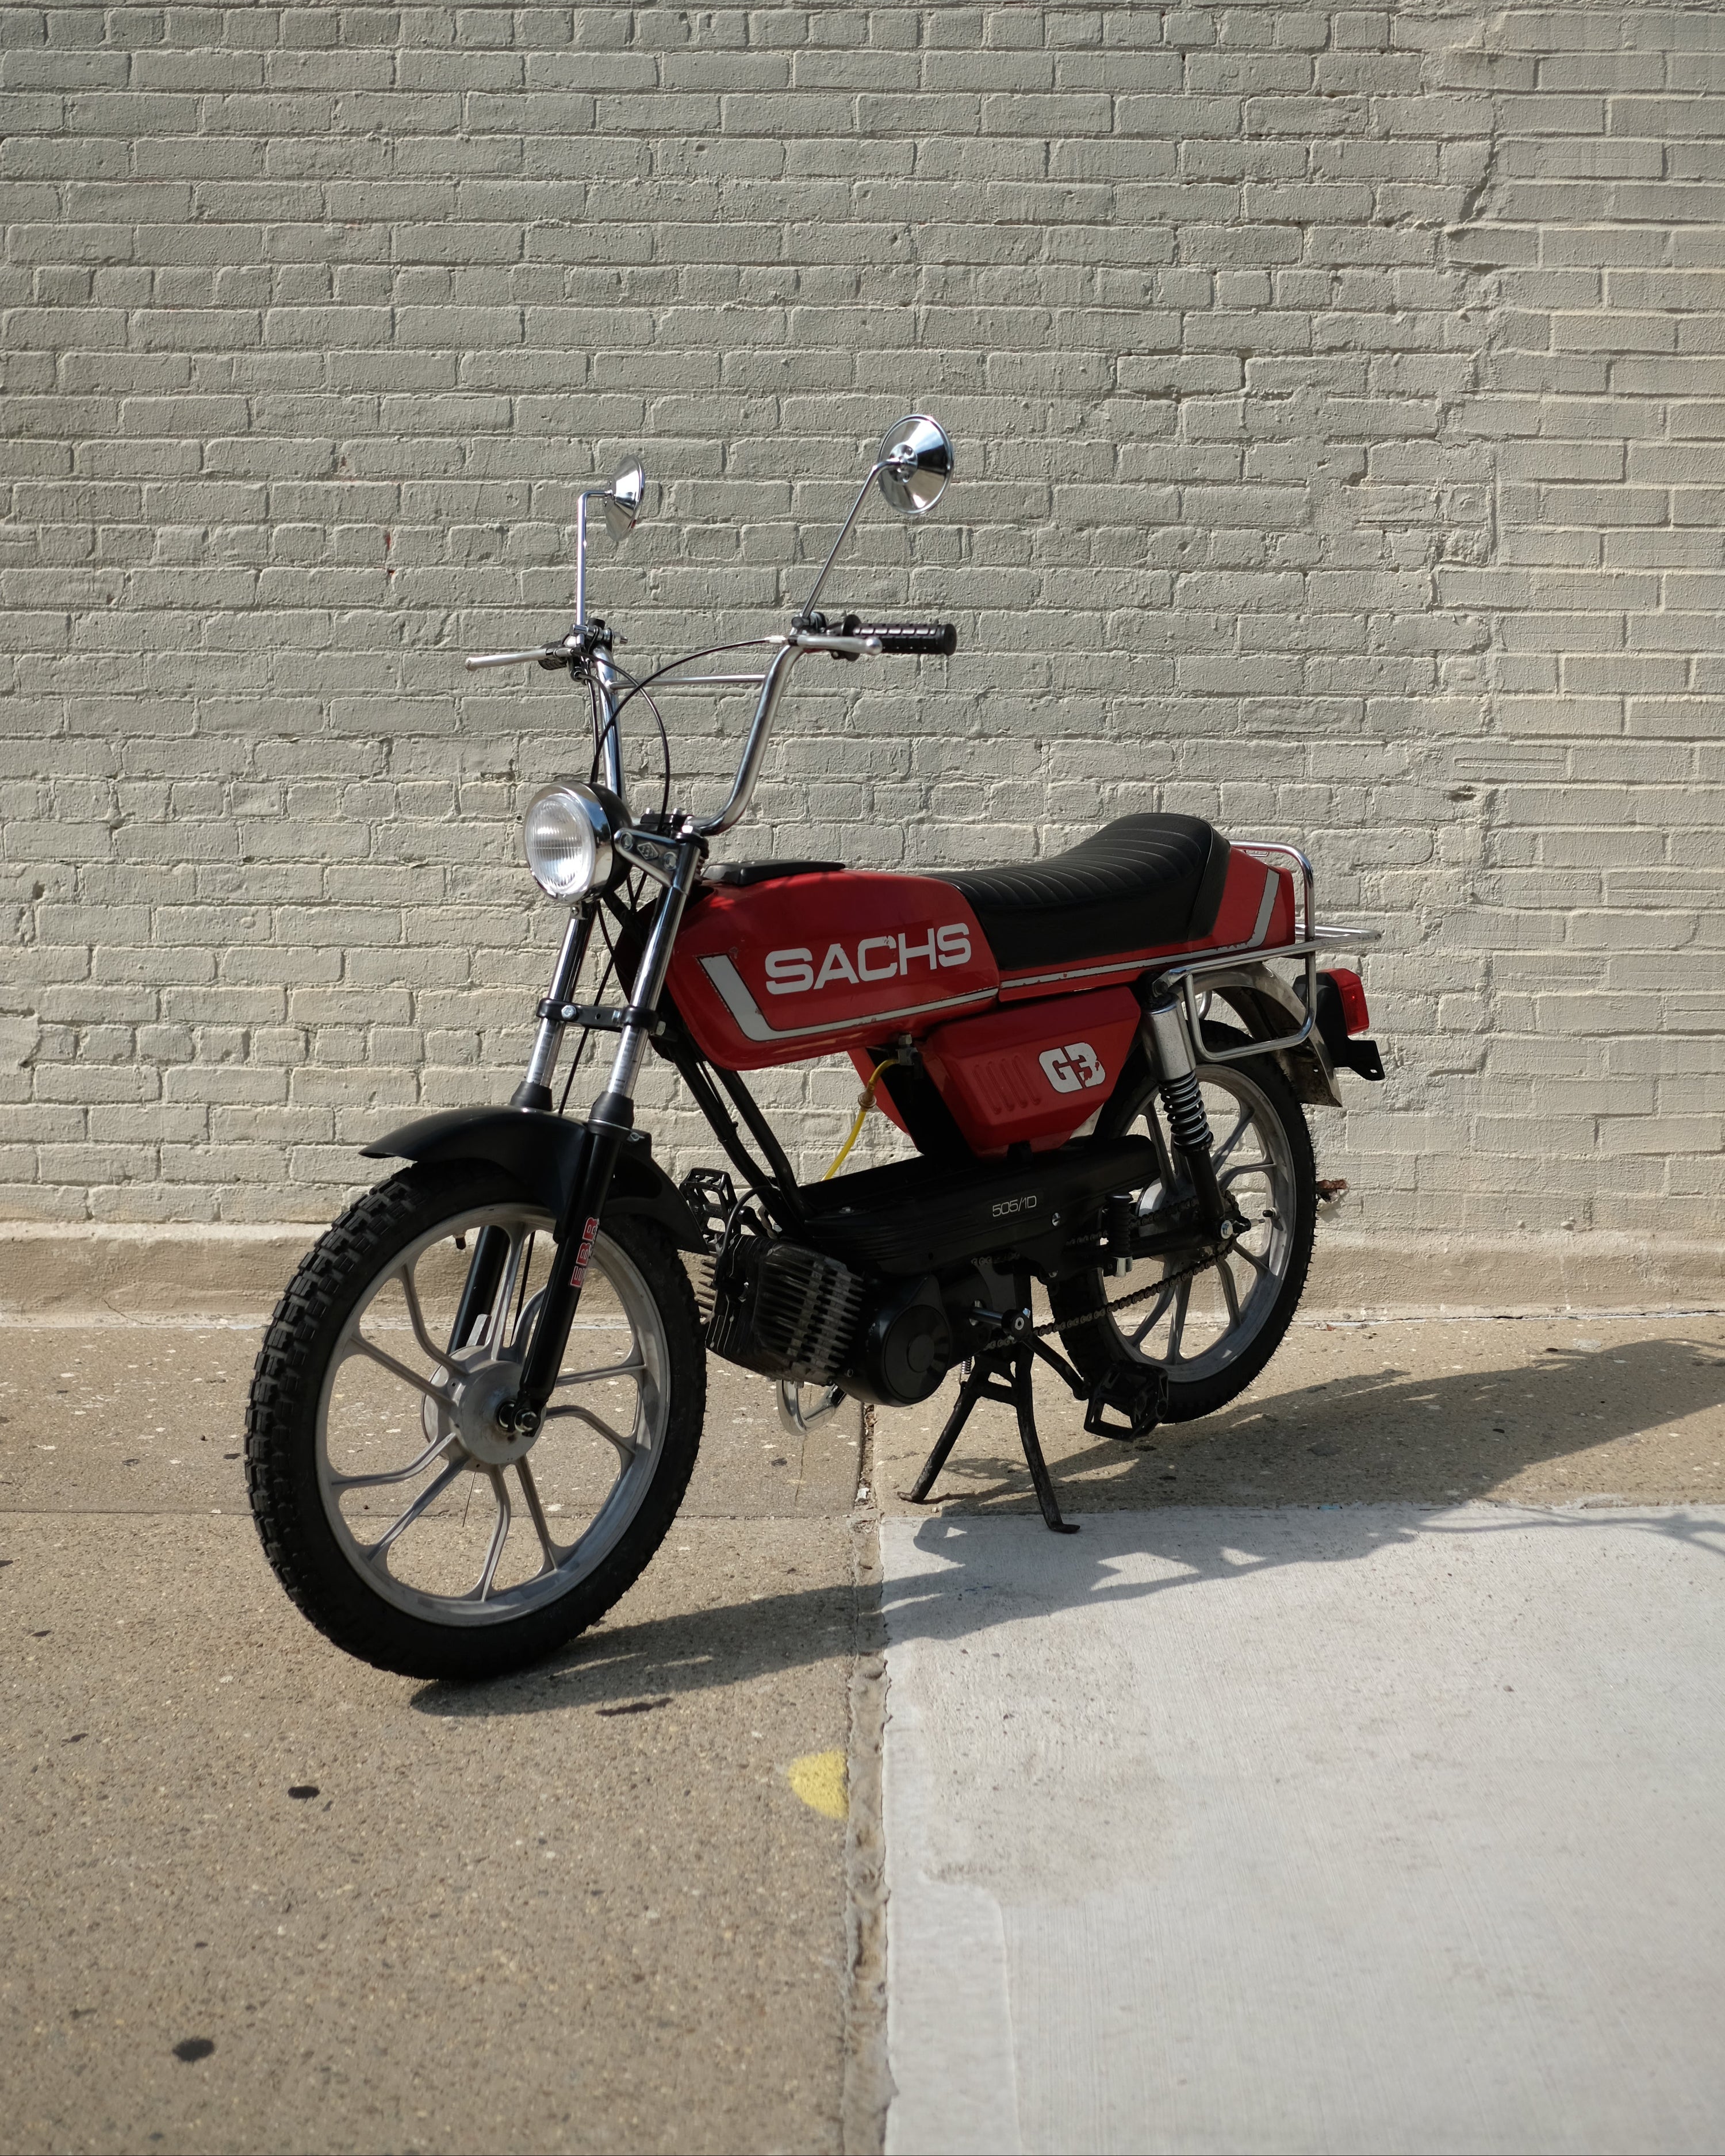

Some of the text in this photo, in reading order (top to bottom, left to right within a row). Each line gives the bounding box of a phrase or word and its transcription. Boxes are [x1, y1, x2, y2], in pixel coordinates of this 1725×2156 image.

[765, 923, 972, 995] SACHS
[1038, 1042, 1106, 1093] G3
[570, 1217, 598, 1288] EBR
